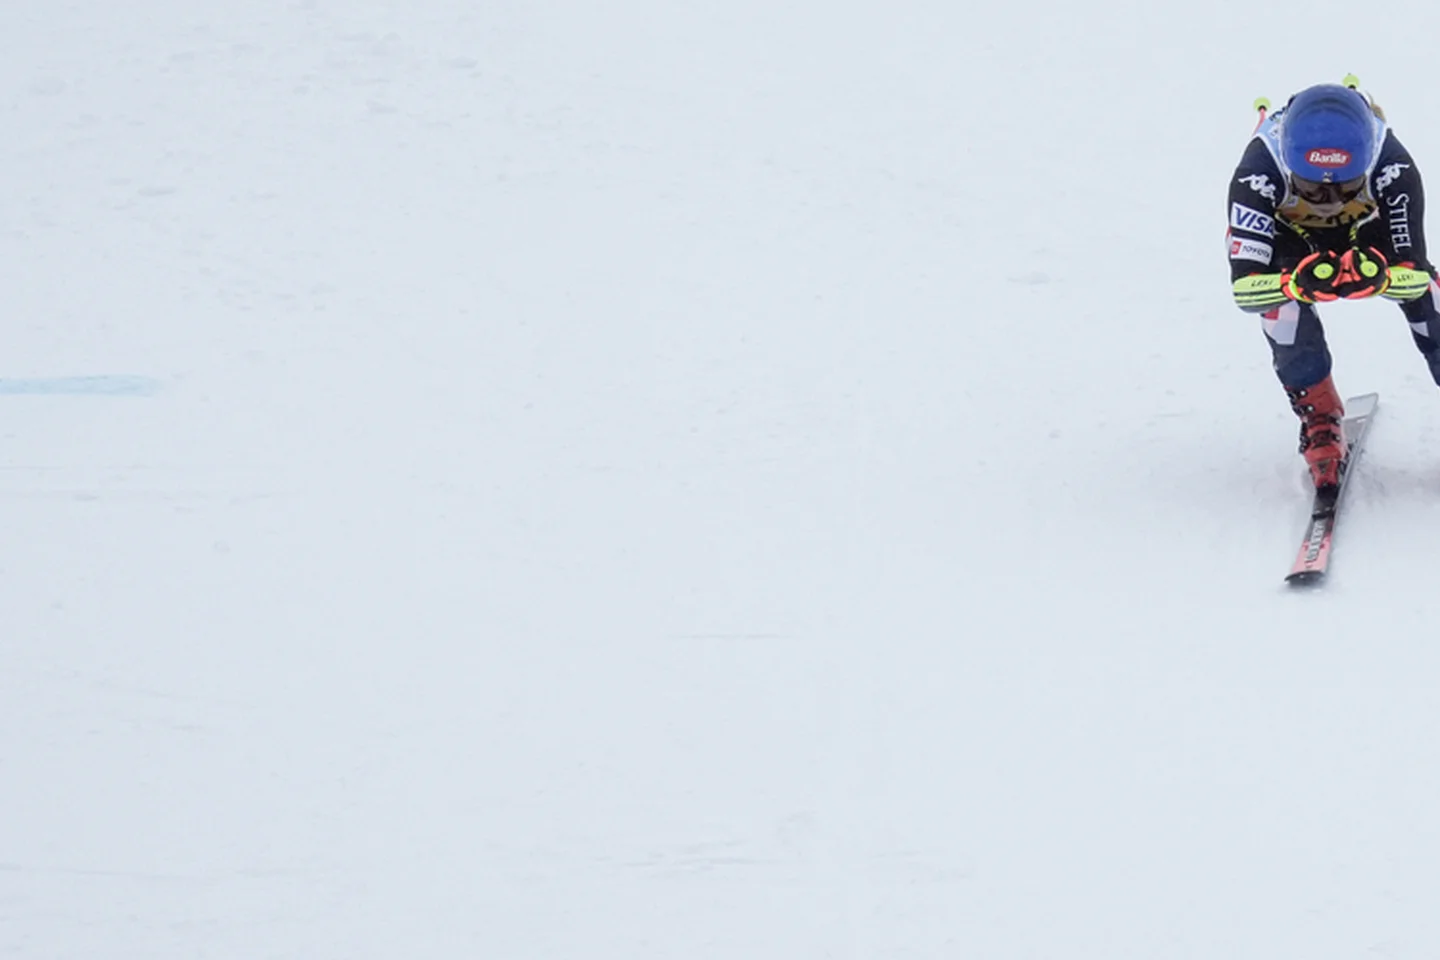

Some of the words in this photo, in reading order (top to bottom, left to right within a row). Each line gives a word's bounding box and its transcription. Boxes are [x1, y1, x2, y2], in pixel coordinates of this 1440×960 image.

[1309, 151, 1347, 164] Barilla
[1234, 206, 1274, 236] VISA
[1386, 193, 1412, 254] STIFEL
